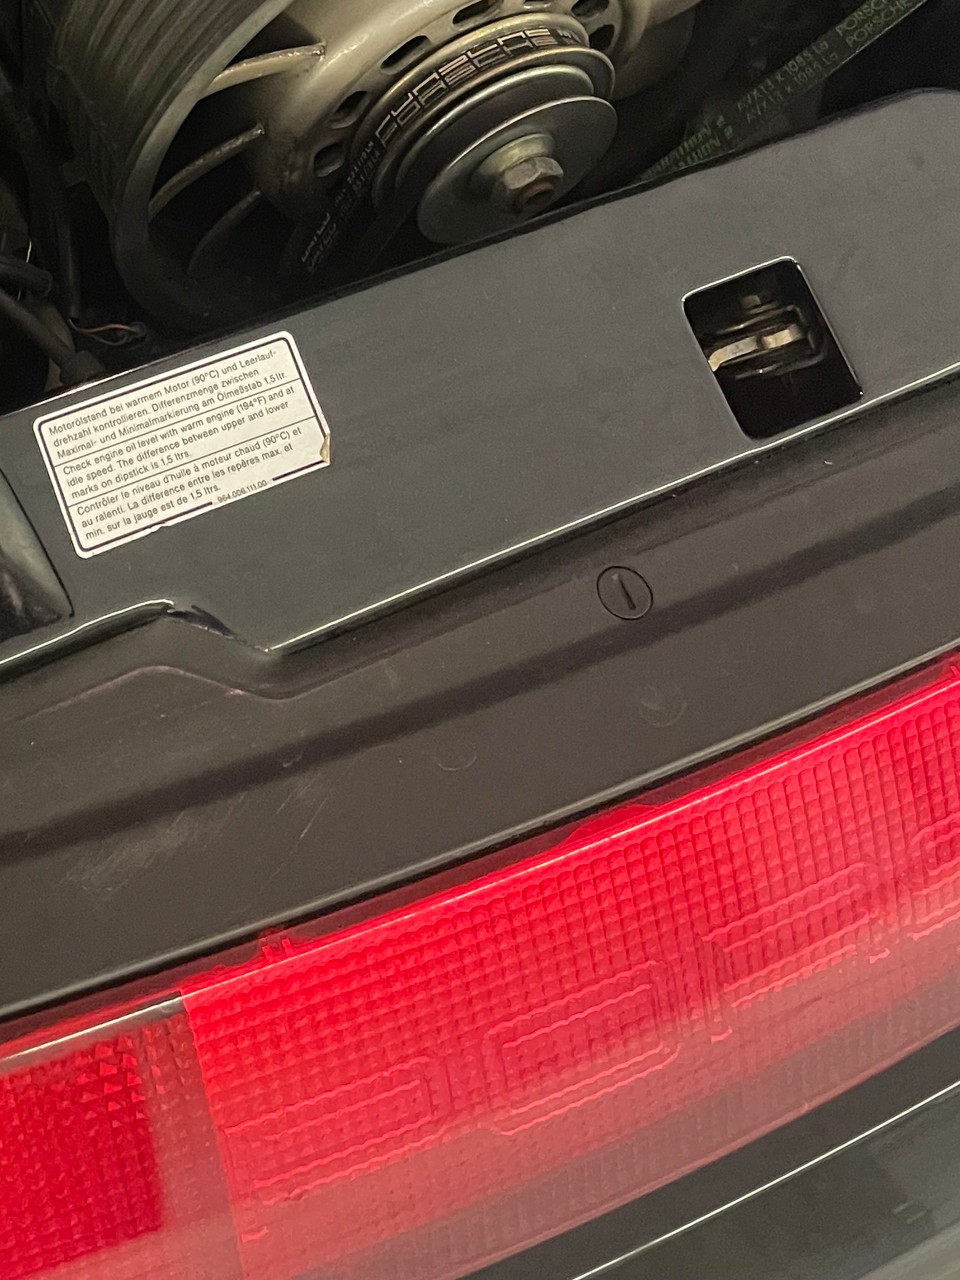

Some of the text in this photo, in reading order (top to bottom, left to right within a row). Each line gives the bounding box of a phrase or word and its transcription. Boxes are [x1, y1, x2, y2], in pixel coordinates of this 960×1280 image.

[48, 407, 108, 436] Motorölstand
[108, 402, 124, 415] bei
[124, 390, 163, 409] warmem
[163, 380, 190, 395] Motor
[191, 368, 220, 387] (90°C)
[220, 362, 239, 375] und
[53, 368, 260, 448] drehzahl kontrollieren. Differenzmenge zwischen
[62, 385, 295, 476] Check engine oil level with warm engine (194°F) and at
[99, 430, 117, 445] und
[117, 402, 201, 437] Minimalmarkierung
[201, 397, 216, 408] am
[216, 380, 263, 402] Ölmeßstab
[66, 401, 289, 488] idle speed. The difference between upper and lower
[71, 483, 100, 500] marks
[100, 478, 114, 489] on
[114, 464, 150, 484] dipstick
[149, 461, 160, 470] is
[173, 450, 193, 462] ltrs.
[76, 494, 119, 516] Contrôler
[120, 490, 131, 500] le
[131, 479, 161, 496] niveau
[200, 452, 232, 470] moteur
[234, 440, 262, 458] chaud
[262, 430, 291, 449] (90°C)
[291, 426, 302, 436] et
[81, 518, 94, 529] au
[126, 500, 140, 511] La
[140, 483, 186, 506] difference
[187, 474, 211, 489] entre
[211, 468, 226, 479] les
[283, 442, 294, 453] et
[84, 528, 106, 540] min.
[106, 520, 121, 533] sur
[122, 517, 133, 526] la
[132, 507, 159, 525] jauge
[160, 499, 175, 512] est
[176, 495, 189, 506] de
[202, 484, 222, 496] ltrs.
